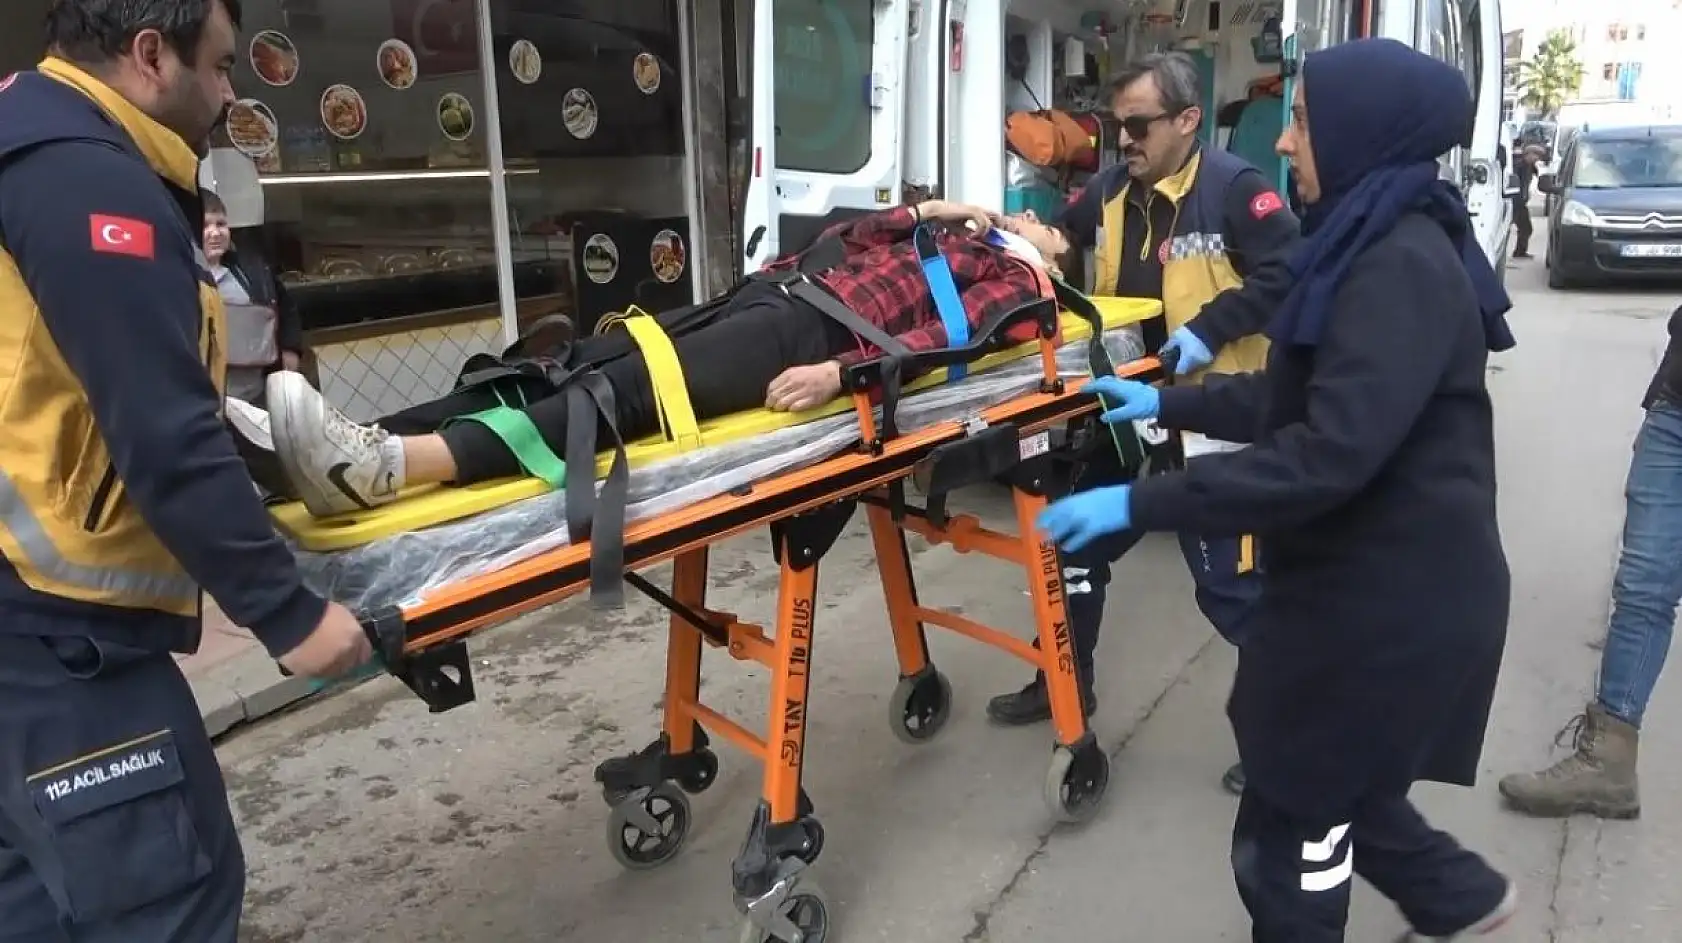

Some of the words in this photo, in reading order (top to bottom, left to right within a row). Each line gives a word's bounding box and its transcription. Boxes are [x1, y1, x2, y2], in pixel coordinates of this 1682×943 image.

[791, 597, 810, 640] PLUS
[784, 699, 802, 734] TAY
[45, 779, 72, 801] 112
[73, 765, 111, 791] ACİL
[109, 748, 165, 777] SAĞLIK
